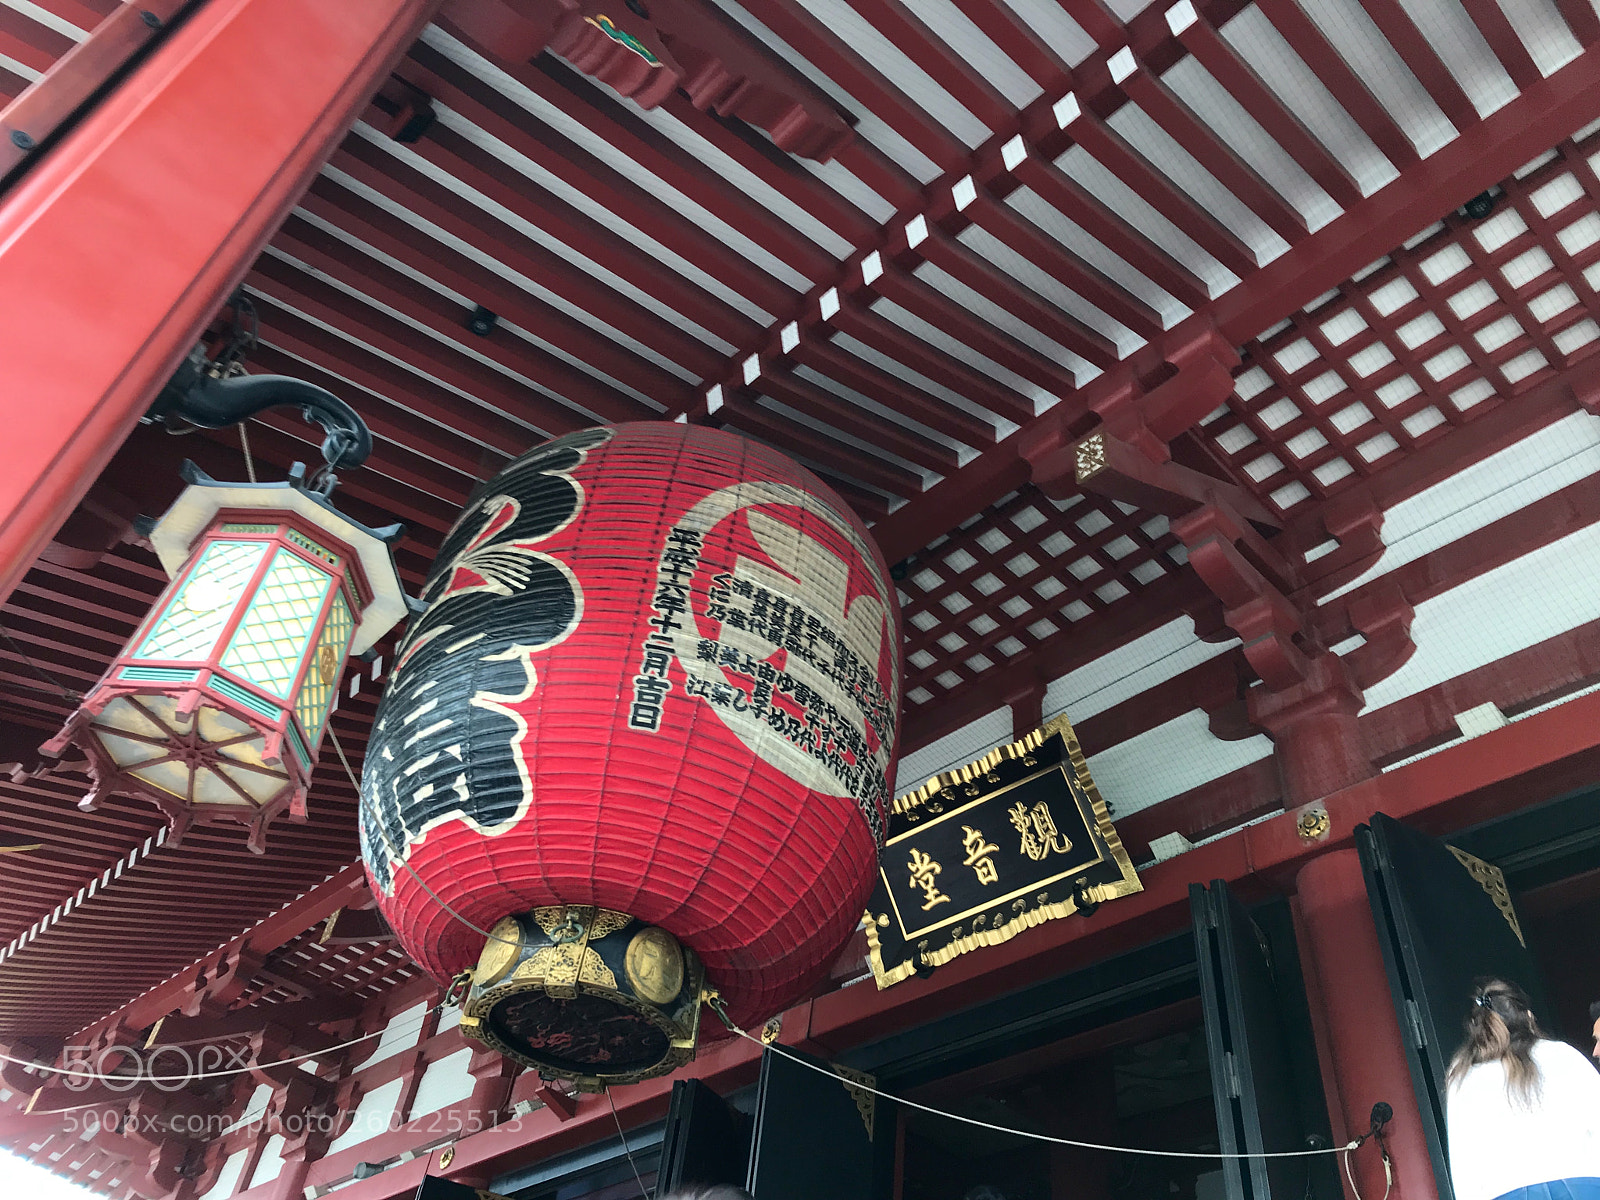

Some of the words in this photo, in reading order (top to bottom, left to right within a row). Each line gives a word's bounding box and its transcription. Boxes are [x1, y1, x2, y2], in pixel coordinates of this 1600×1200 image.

[707, 573, 732, 621] くに乃
[686, 640, 719, 699] 梨江
[733, 654, 757, 712] よし
[750, 662, 777, 719] 由良子
[768, 672, 794, 732] ゆめ
